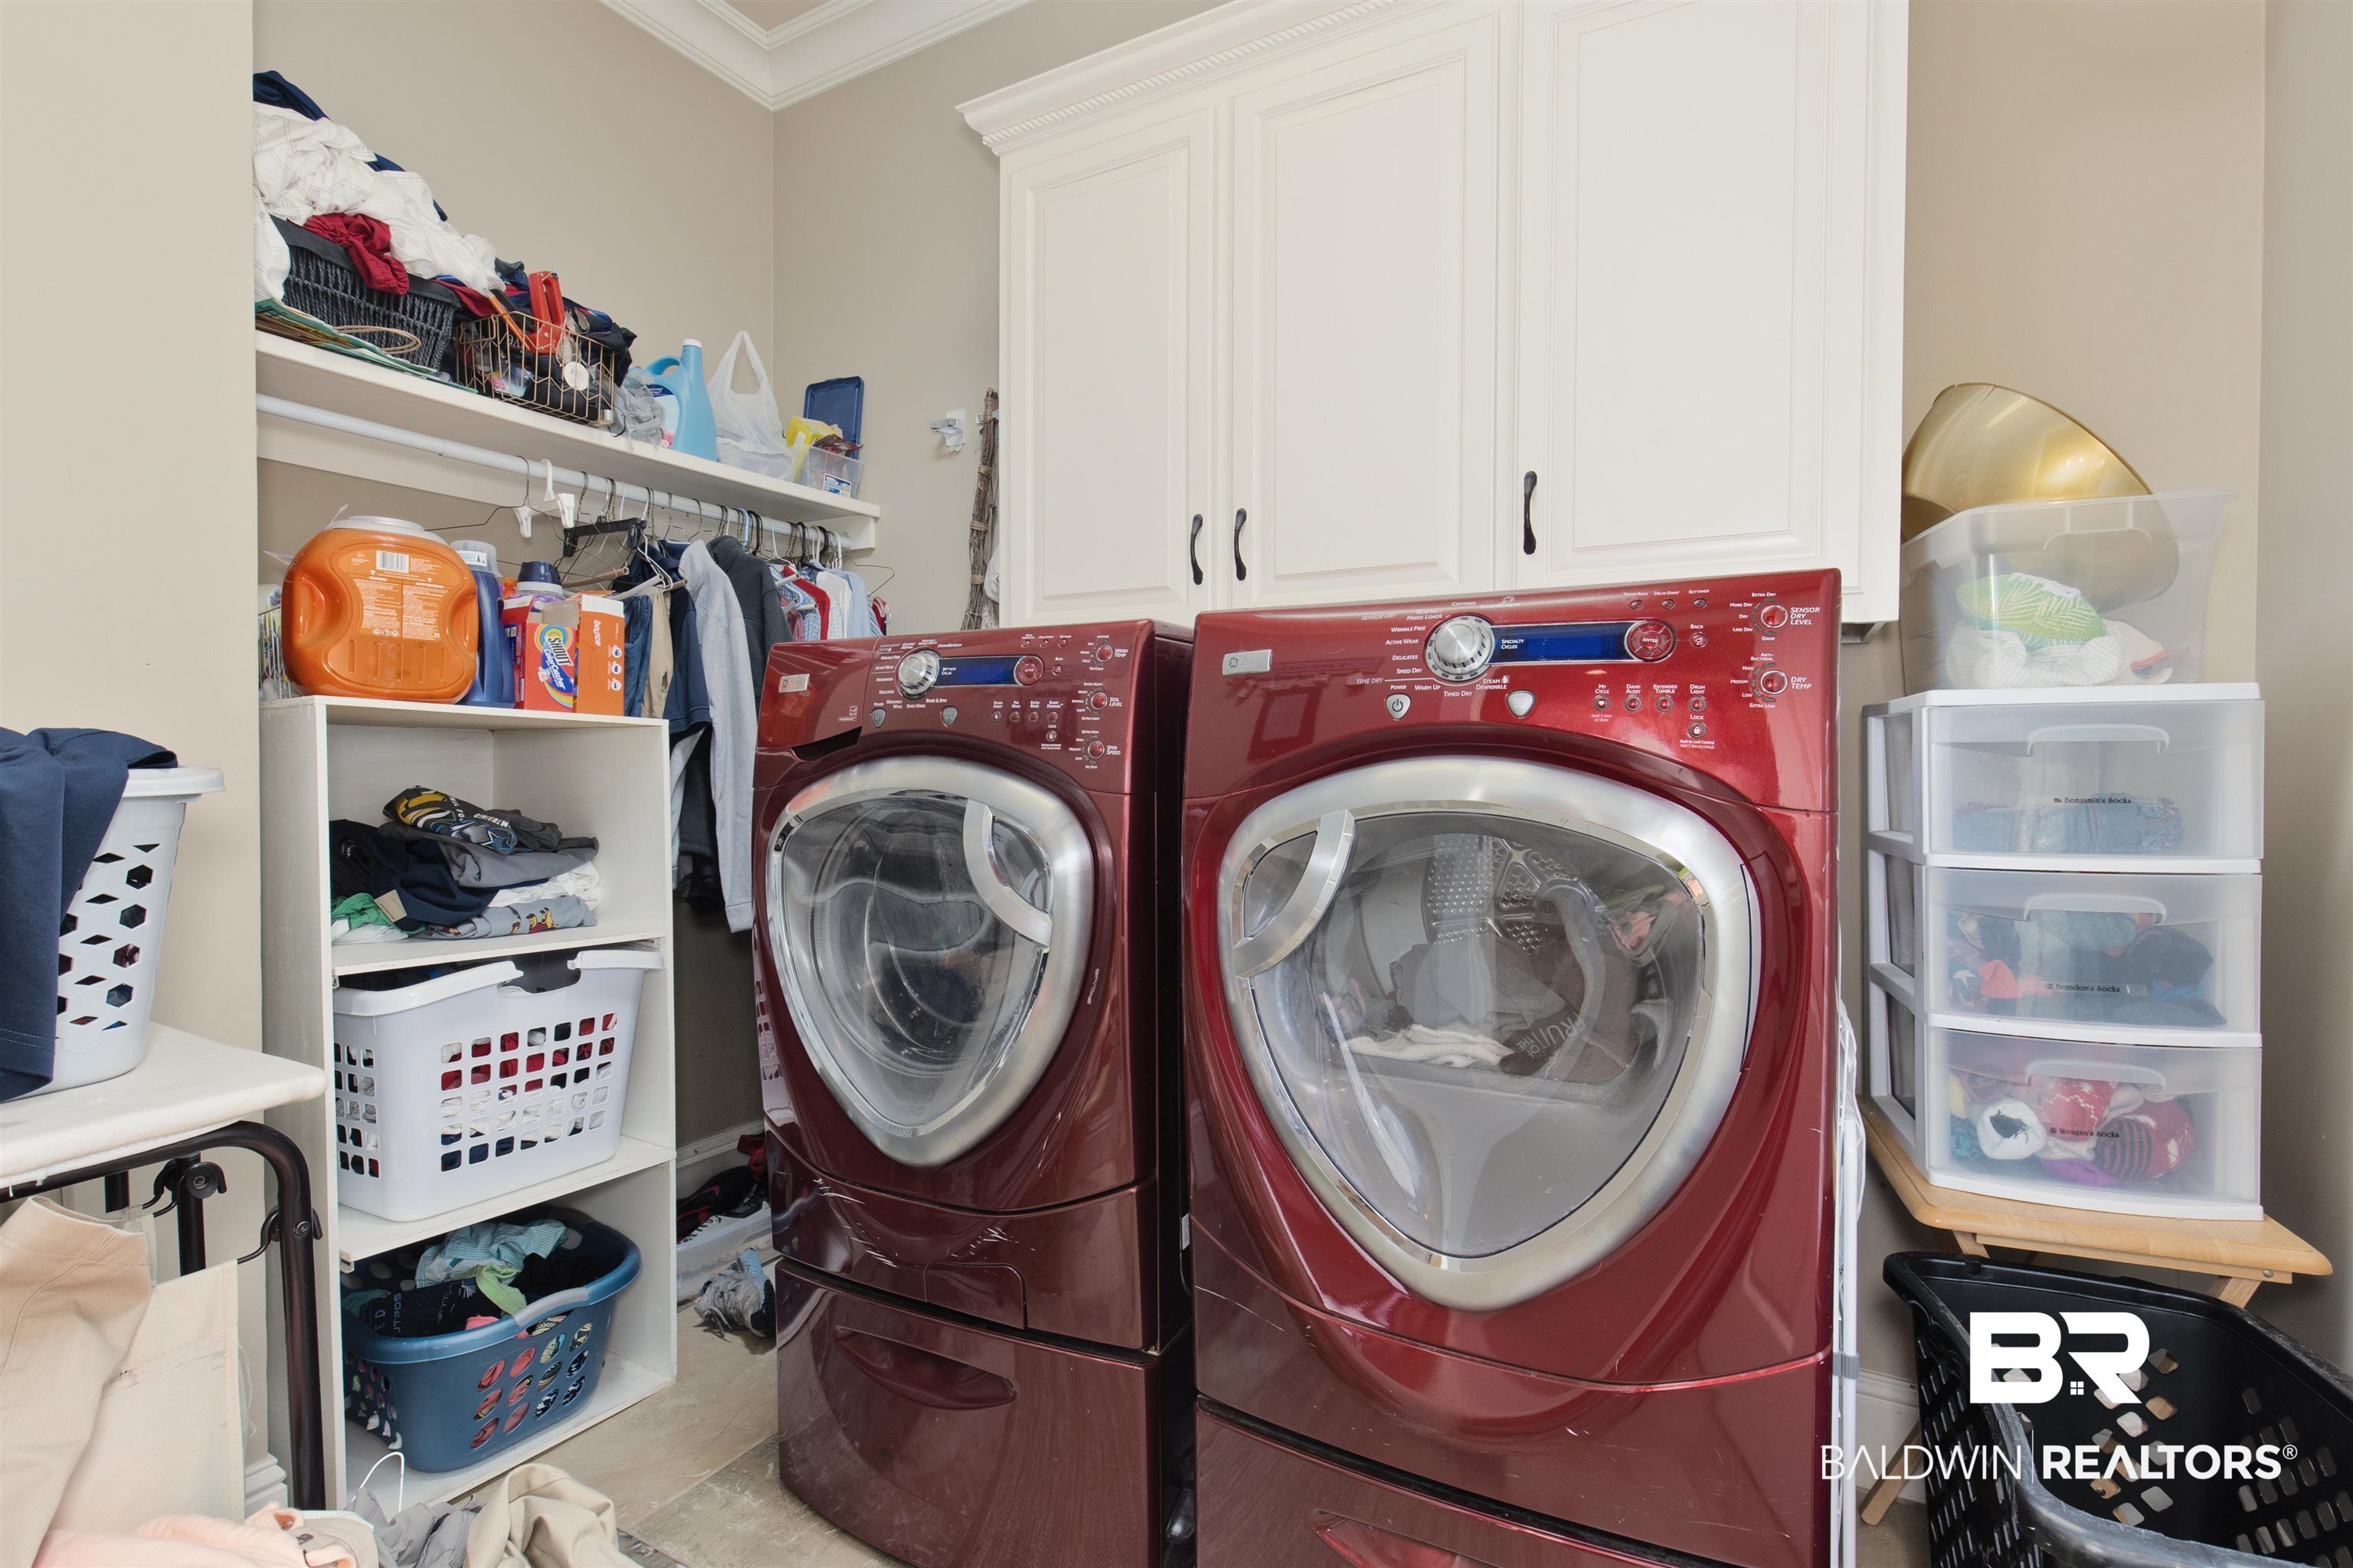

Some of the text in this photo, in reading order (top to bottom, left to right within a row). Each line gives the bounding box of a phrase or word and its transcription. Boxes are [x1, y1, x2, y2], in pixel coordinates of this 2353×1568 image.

[548, 637, 573, 666] SHOUT
[1517, 1036, 1534, 1051] THE
[2060, 1128, 2094, 1136] Meagan's
